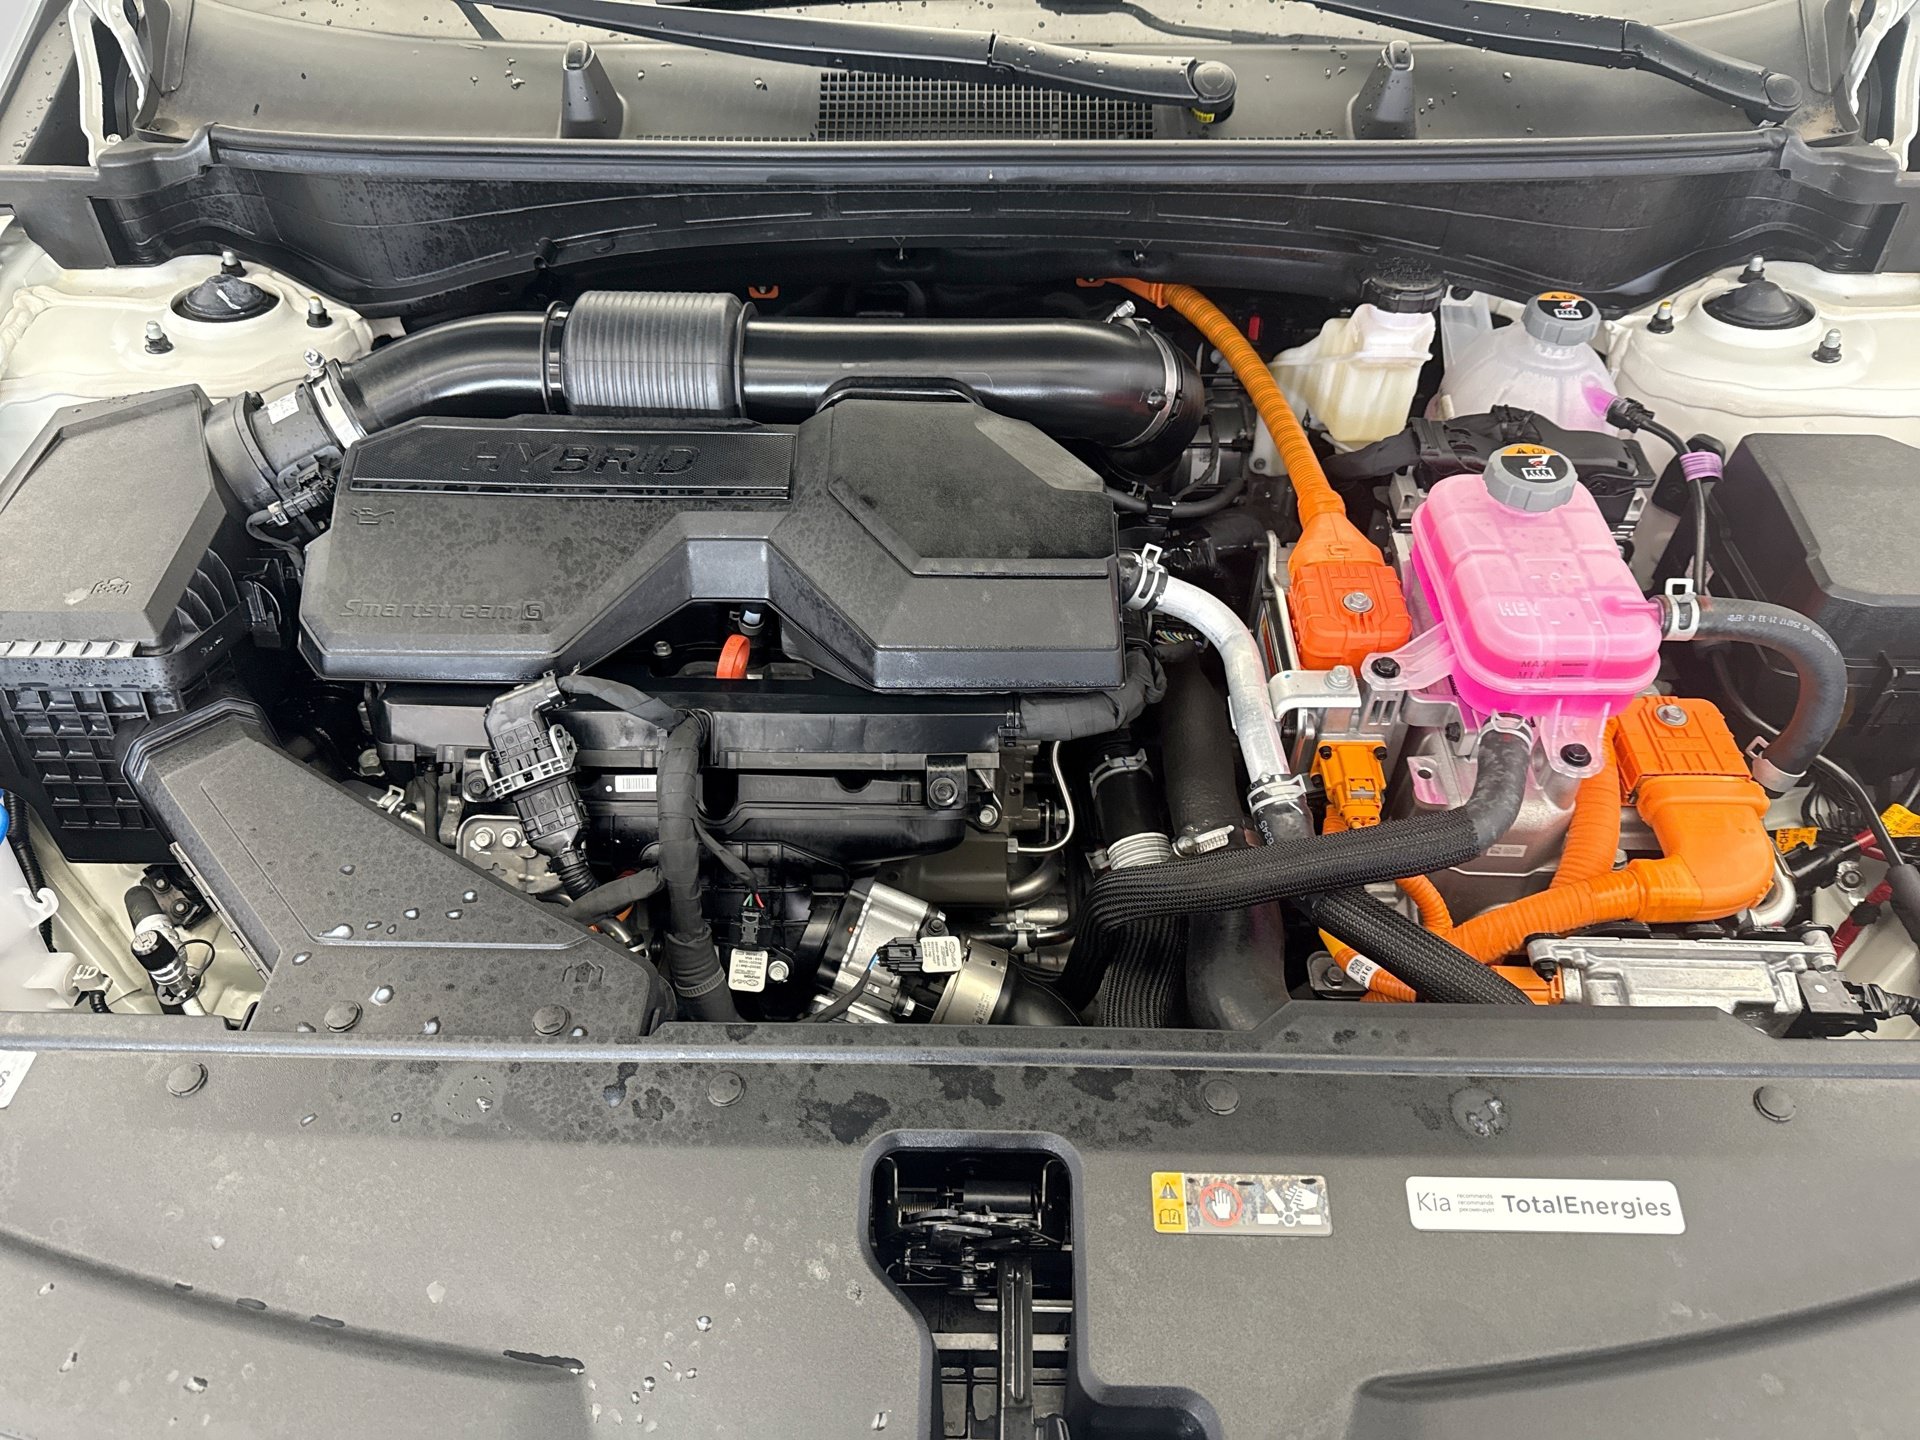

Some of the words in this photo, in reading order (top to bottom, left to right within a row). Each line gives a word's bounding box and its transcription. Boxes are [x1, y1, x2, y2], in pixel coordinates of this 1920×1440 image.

[461, 441, 699, 475] HYBRID
[1520, 660, 1549, 668] MAX
[1416, 1191, 1452, 1212] Kia
[1501, 1194, 1672, 1219] TotalEnergies
